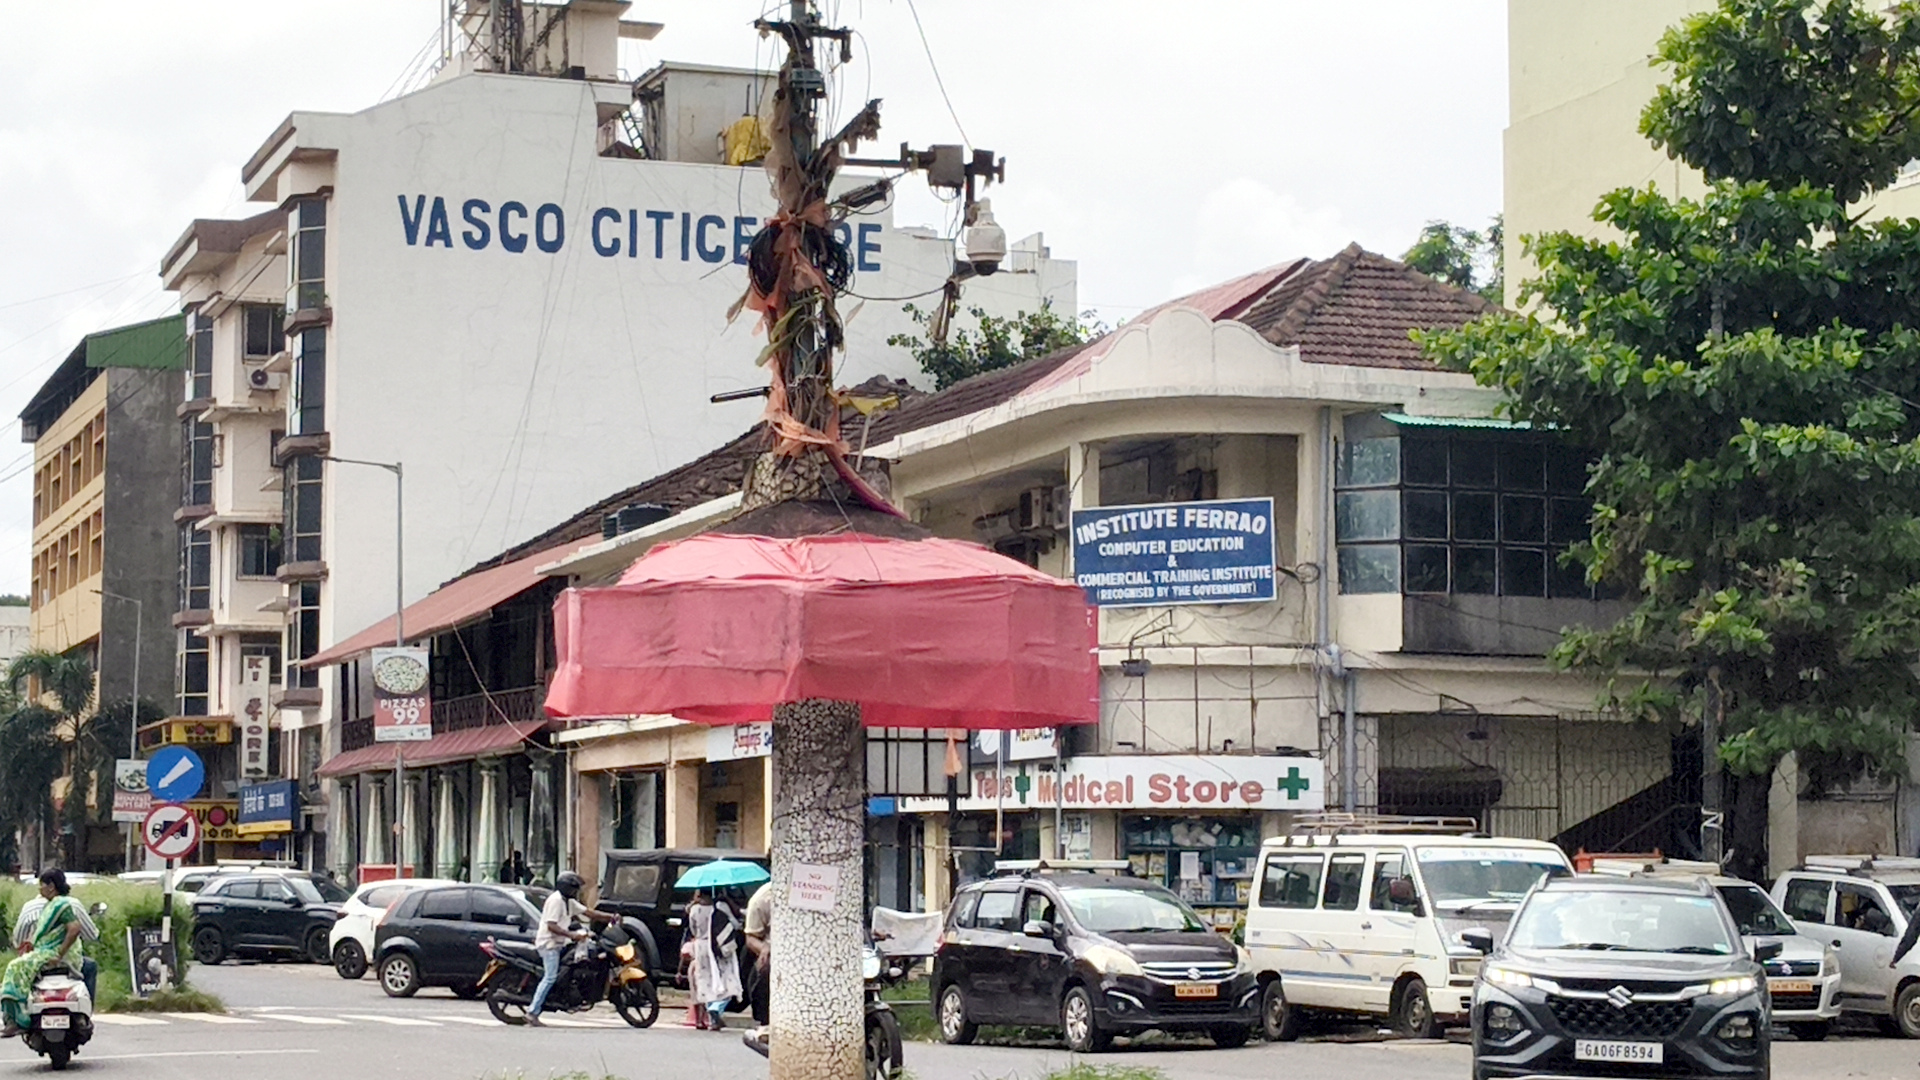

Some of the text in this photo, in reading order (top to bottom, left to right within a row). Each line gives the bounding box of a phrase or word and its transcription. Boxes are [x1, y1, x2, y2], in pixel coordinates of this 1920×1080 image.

[397, 194, 882, 272] VASCO CITICEE
[1076, 508, 1267, 545] INSTITUTE FERRAO
[1098, 537, 1244, 556] COMPUTER EDUCATION
[1166, 554, 1178, 568] &
[1078, 565, 1271, 587] COMMERCIAL TRAINING INSTITUTE
[1156, 585, 1169, 598] BY
[1172, 585, 1191, 597] THE
[380, 698, 426, 710] PIZZAS
[393, 707, 420, 725] 99
[1037, 773, 1134, 804] Medical
[1148, 773, 1264, 804] Store
[792, 881, 834, 892] STANDING
[801, 892, 822, 901] HERE
[1585, 1044, 1653, 1058] GA06F8594
